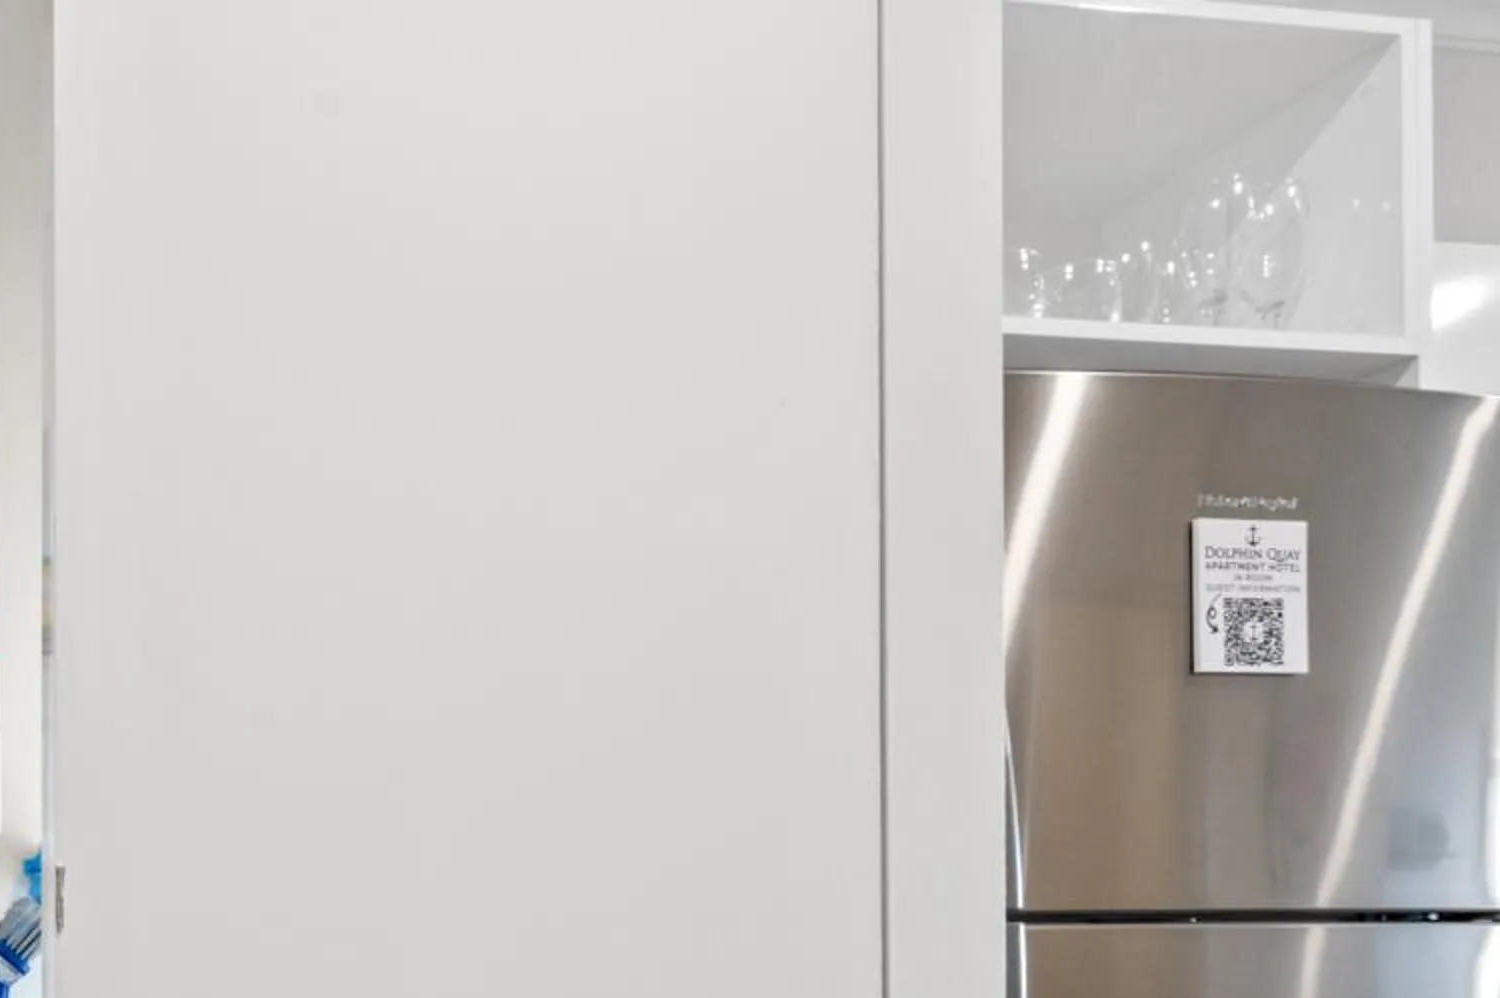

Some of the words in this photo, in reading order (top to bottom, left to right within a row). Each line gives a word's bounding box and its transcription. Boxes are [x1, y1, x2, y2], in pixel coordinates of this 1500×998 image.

[1204, 546, 1263, 559] DOLPHIN
[1266, 547, 1300, 562] QUAY
[1204, 561, 1265, 571] APARTMENT
[1267, 562, 1300, 573] HOTEL
